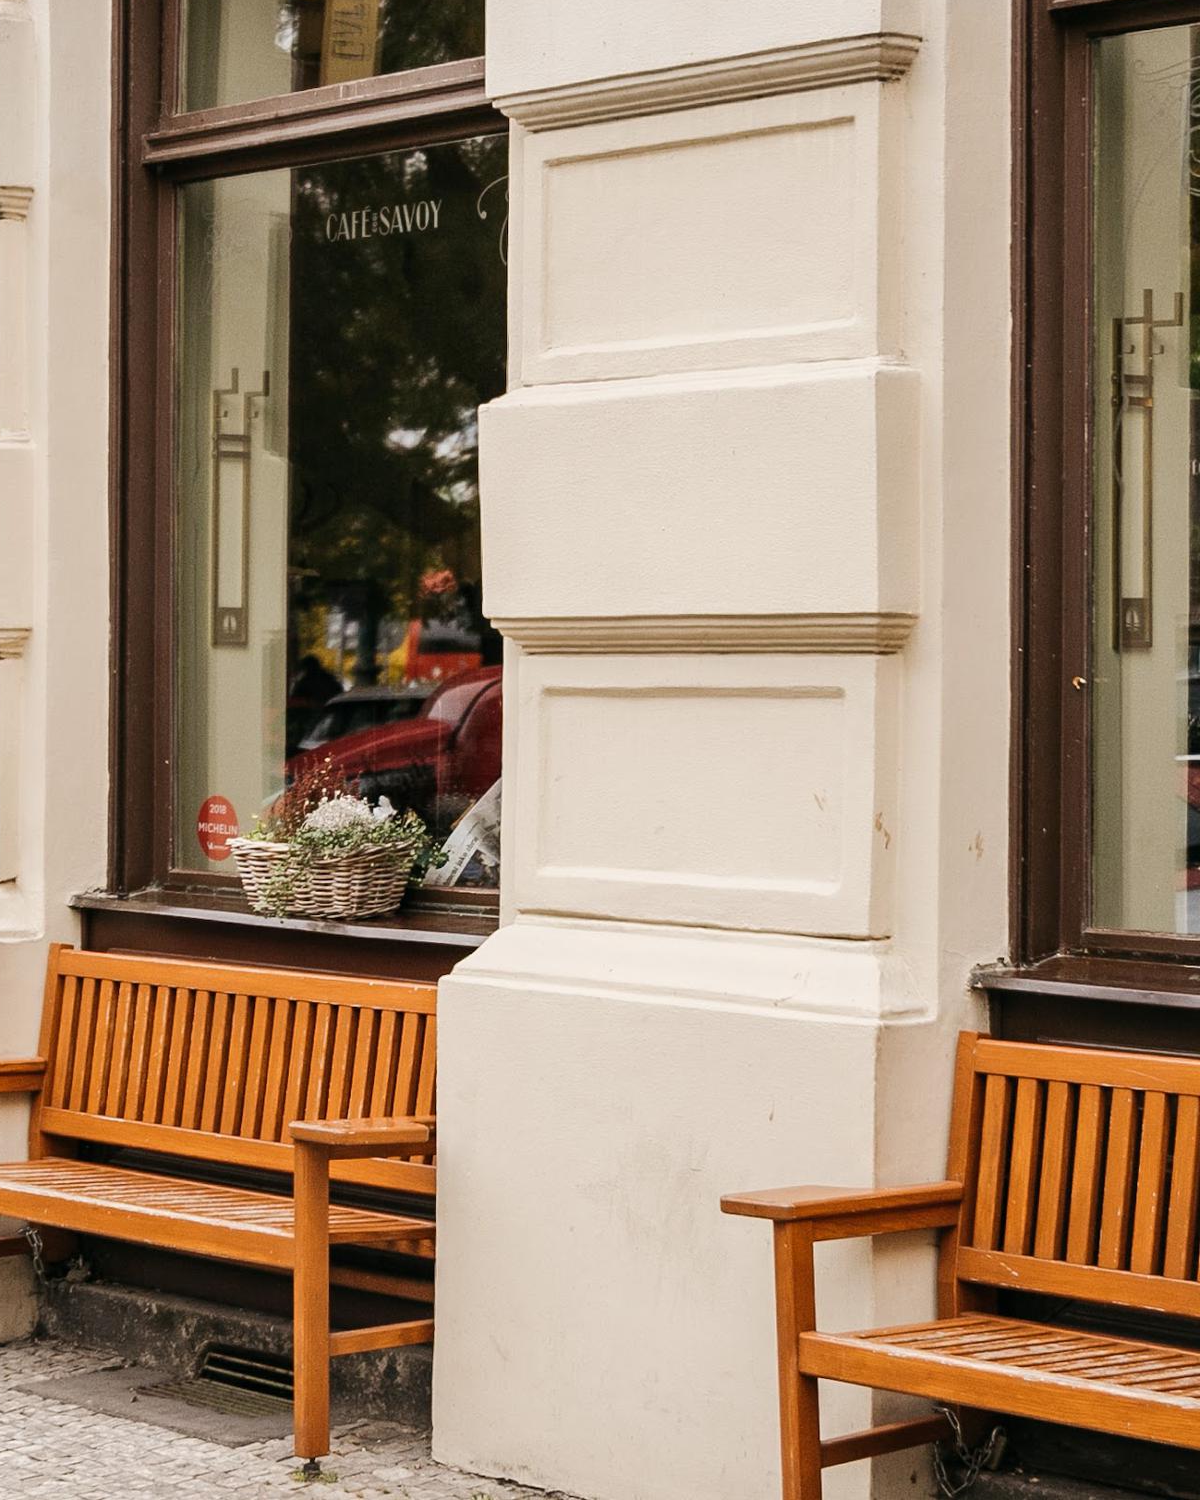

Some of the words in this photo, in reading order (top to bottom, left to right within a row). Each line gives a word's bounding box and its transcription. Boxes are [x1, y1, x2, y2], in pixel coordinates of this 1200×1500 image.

[326, 205, 372, 242] CAFÉ
[379, 199, 442, 236] SAVOY
[198, 821, 238, 837] MICHELIN
